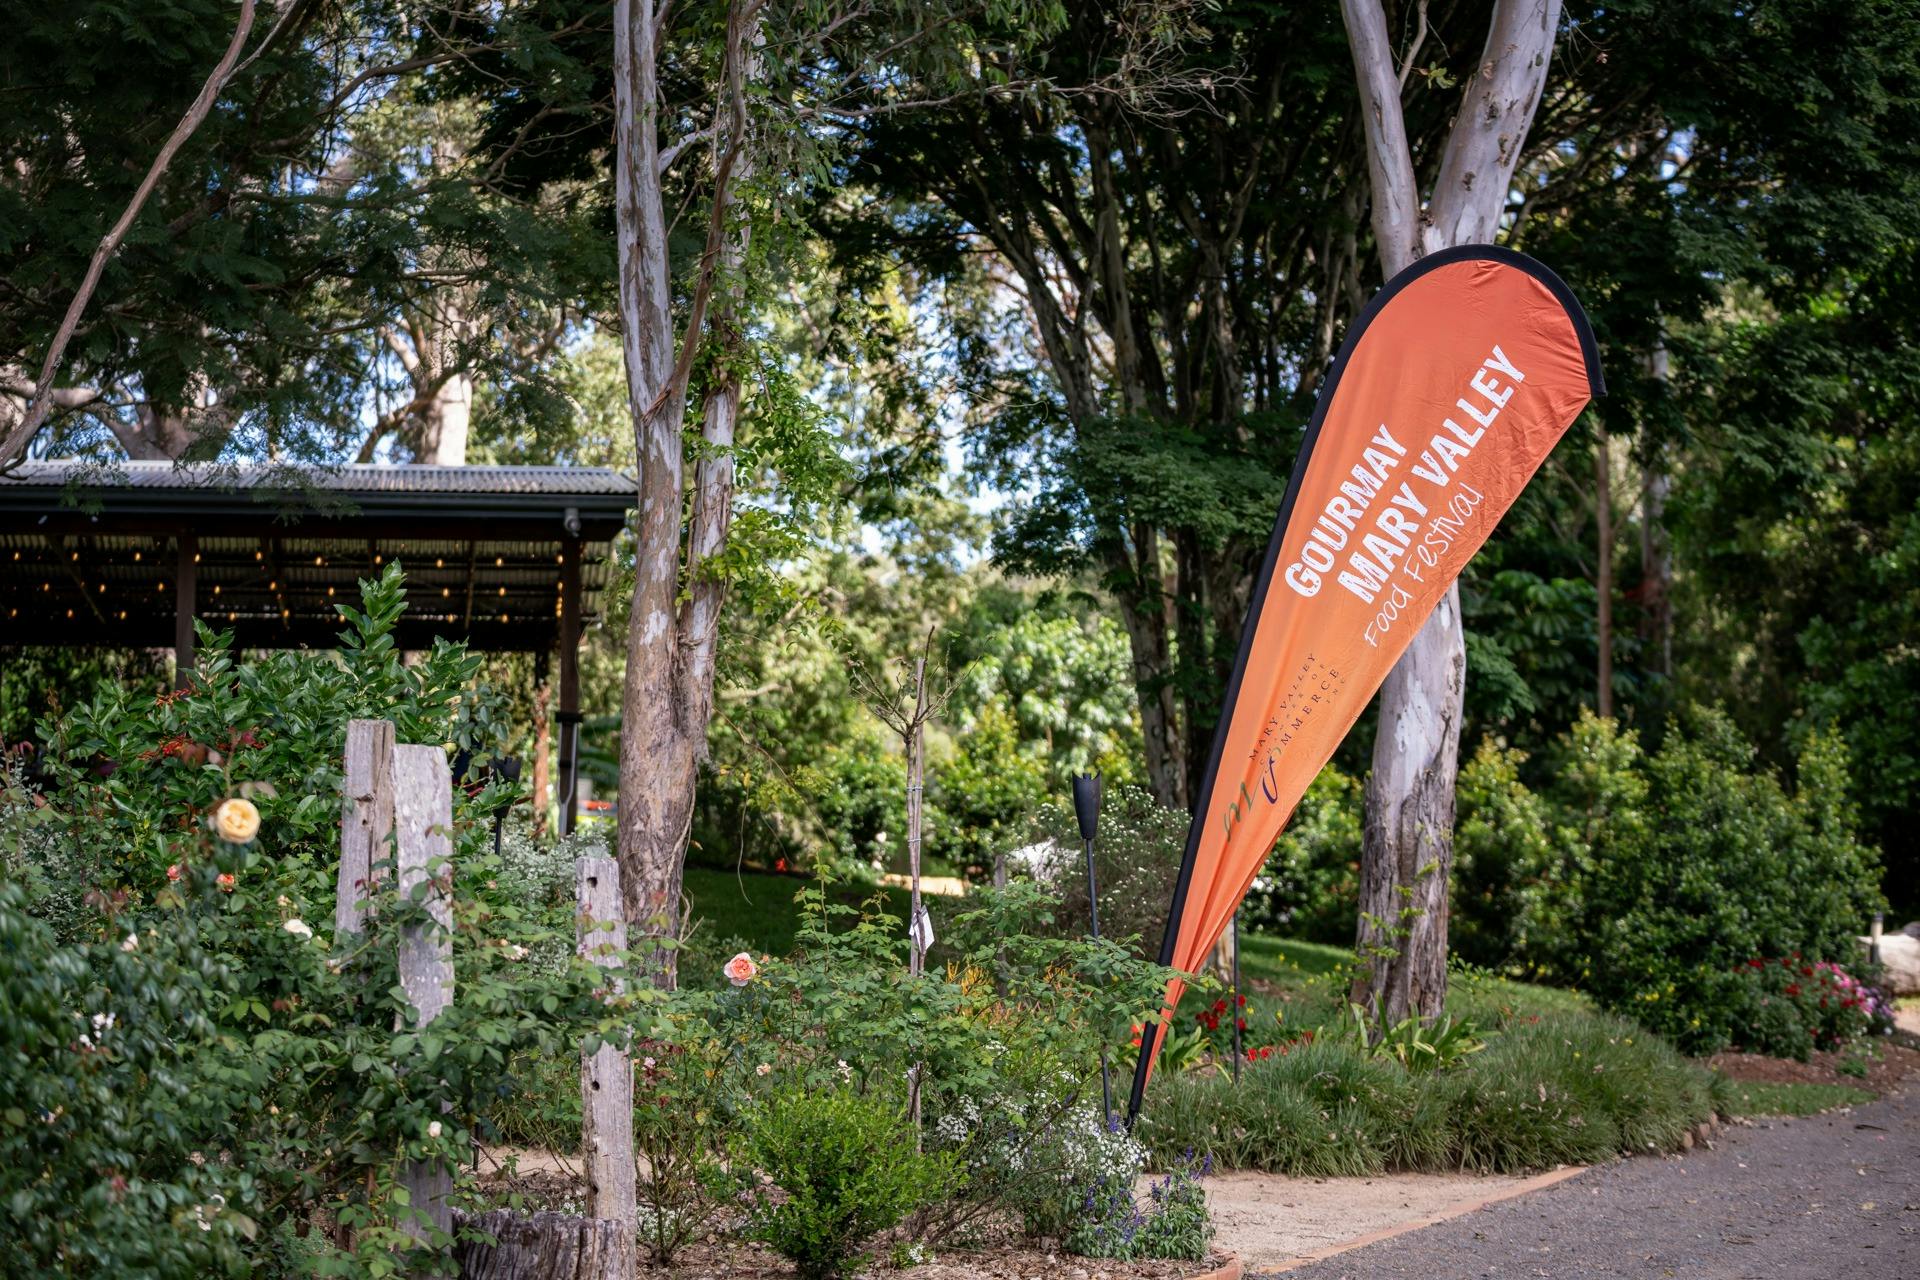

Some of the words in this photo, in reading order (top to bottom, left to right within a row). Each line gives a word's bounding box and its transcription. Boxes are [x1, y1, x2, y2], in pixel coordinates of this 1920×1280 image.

[1285, 423, 1408, 598] GOURMAY
[1338, 482, 1428, 605] MARY
[1411, 344, 1525, 487] VALLEY
[1364, 583, 1413, 648] Food
[1403, 482, 1484, 583] Festival
[1248, 716, 1279, 761] MARY
[1280, 653, 1316, 709] VALLEY
